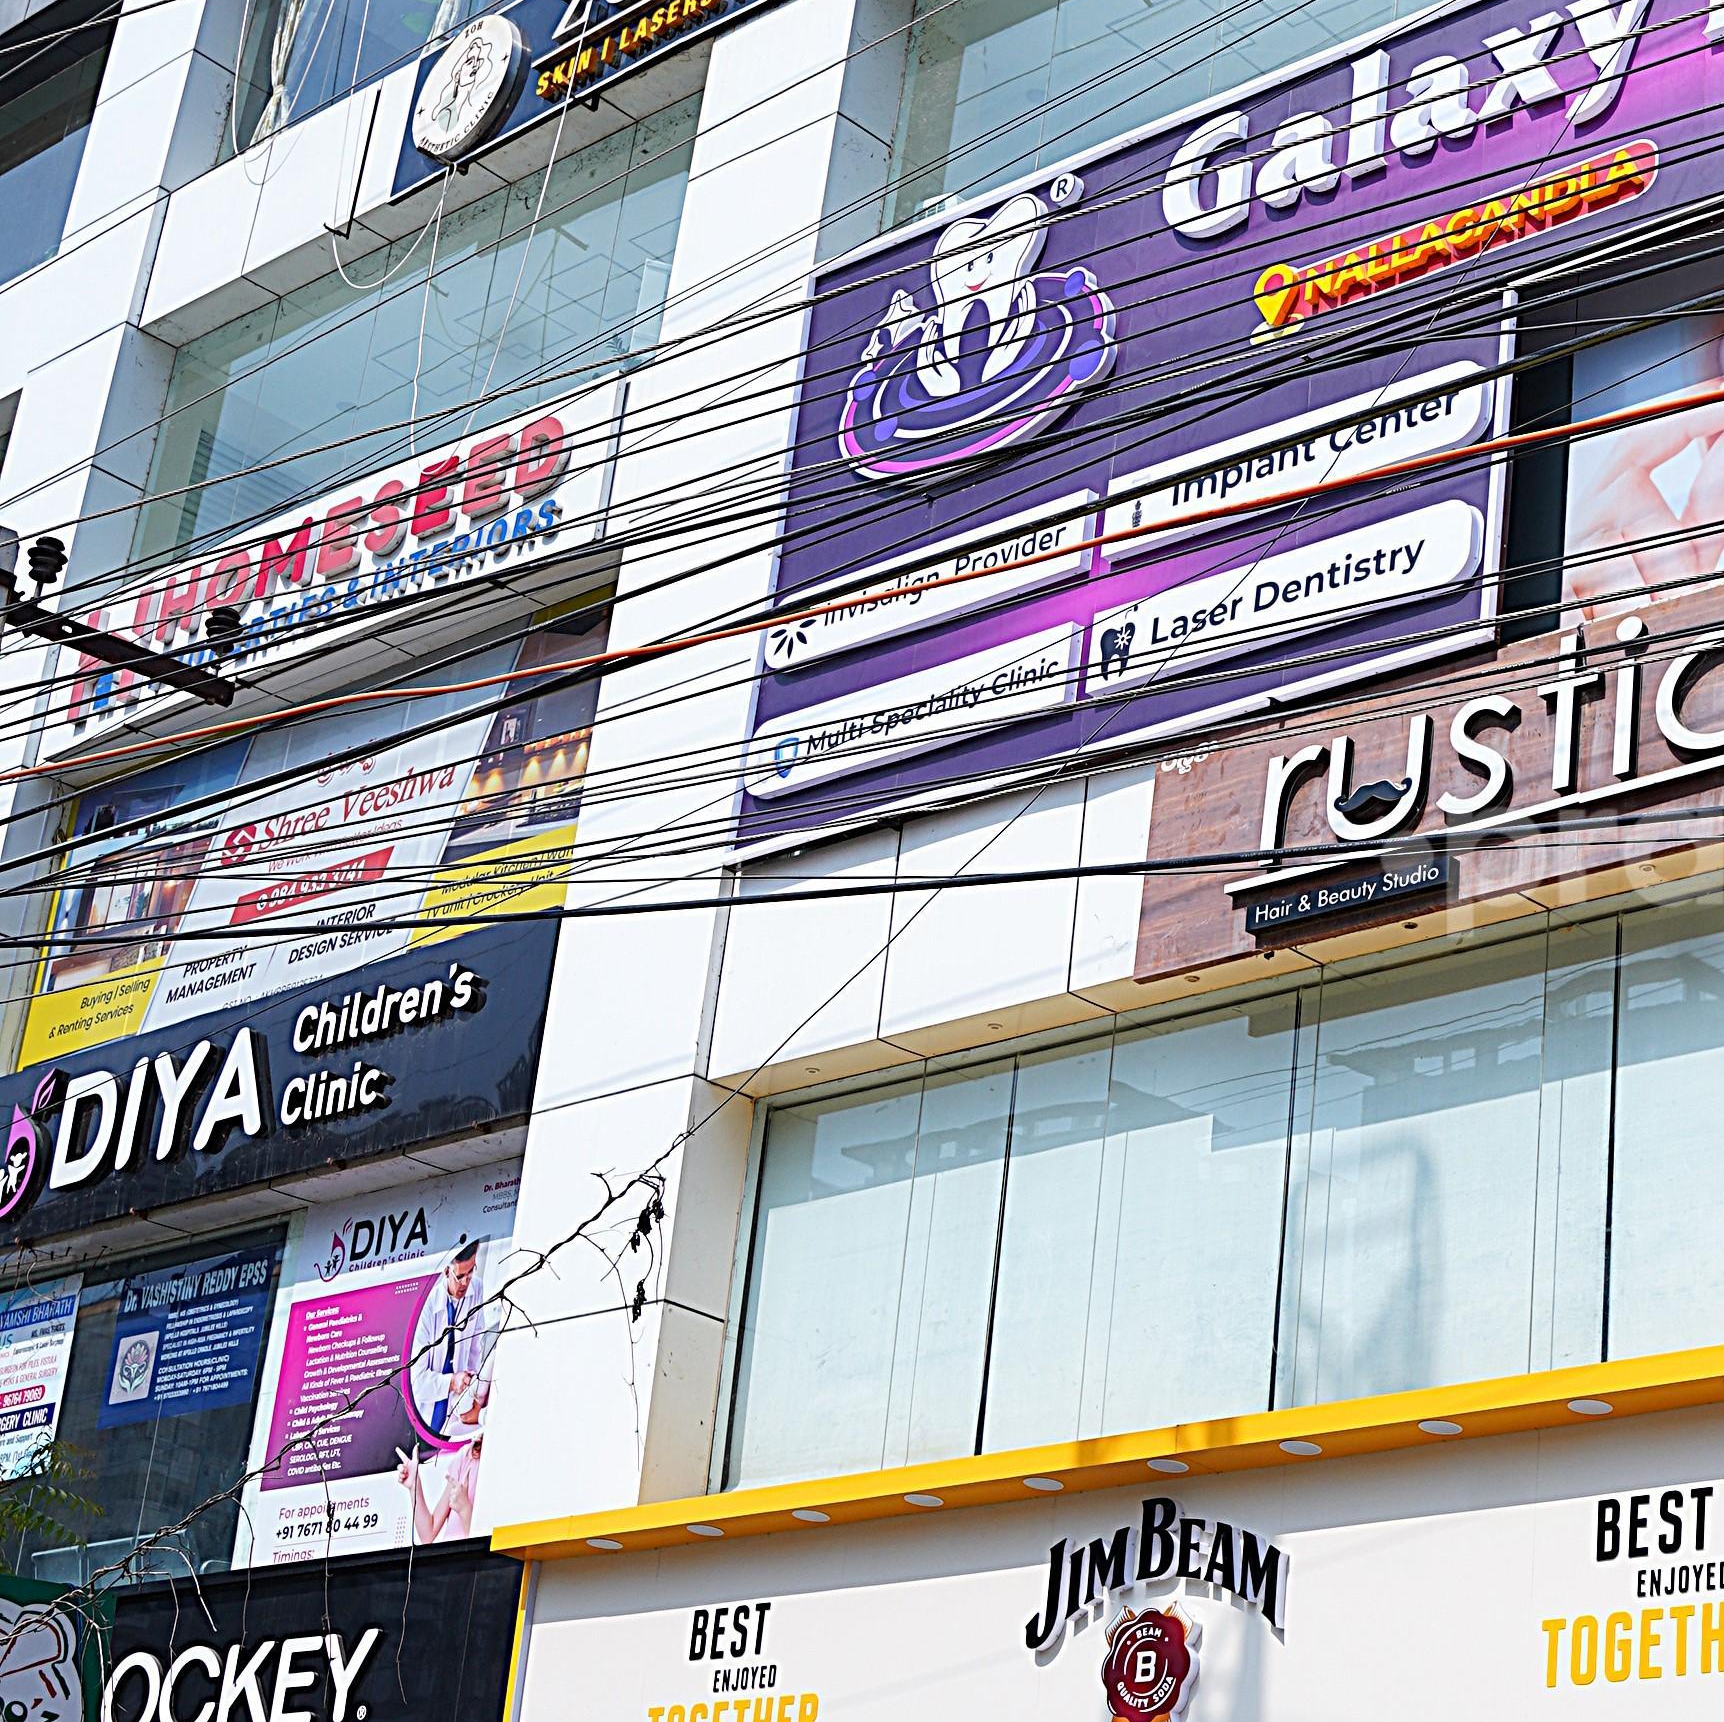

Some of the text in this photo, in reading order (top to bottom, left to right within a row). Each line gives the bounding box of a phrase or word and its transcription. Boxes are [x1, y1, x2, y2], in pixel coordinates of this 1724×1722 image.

[464, 20, 484, 39] ZOH
[536, 46, 600, 97] SKIN
[463, 91, 495, 135] CLINIC
[1304, 148, 1646, 313] NALLAGANDLA
[1172, 389, 1460, 506] Implant Center
[955, 527, 1067, 576] Provider
[1151, 539, 1425, 644] Laser Dentistry
[806, 723, 863, 755] Multi
[991, 658, 1059, 696] Clinic
[258, 806, 331, 852] Shree
[316, 903, 376, 927] INTERIOR
[1255, 864, 1439, 923] Hair & Beauty Studio
[183, 945, 248, 977] PROPERTY
[288, 938, 337, 965] DESIGN
[80, 978, 151, 1010] Buying Selling
[166, 962, 257, 1004] MANAGEMENT
[48, 1003, 134, 1039] & Renting Services
[293, 962, 475, 1054] Children's
[49, 1026, 261, 1189] DIYA
[280, 1061, 382, 1126] Clinic
[349, 1207, 429, 1262] DIYA
[202, 1266, 240, 1296] REDDY
[350, 1250, 425, 1272] Children's Clinic
[23, 1408, 49, 1426] CLINIC
[276, 1527, 294, 1541] +91
[298, 1522, 323, 1538] 7671
[344, 1517, 360, 1530] 44
[363, 1513, 379, 1527] 99
[279, 1497, 370, 1520] For appoitments
[1595, 1486, 1715, 1564] BEST
[1026, 1497, 1281, 1649] JIM BEAM
[689, 1602, 772, 1662] BEST
[1136, 1627, 1162, 1638] BEAM
[713, 1664, 778, 1695] ENJOYED
[1134, 1650, 1156, 1683] B
[1117, 1675, 1174, 1708] QUALITY SODA
